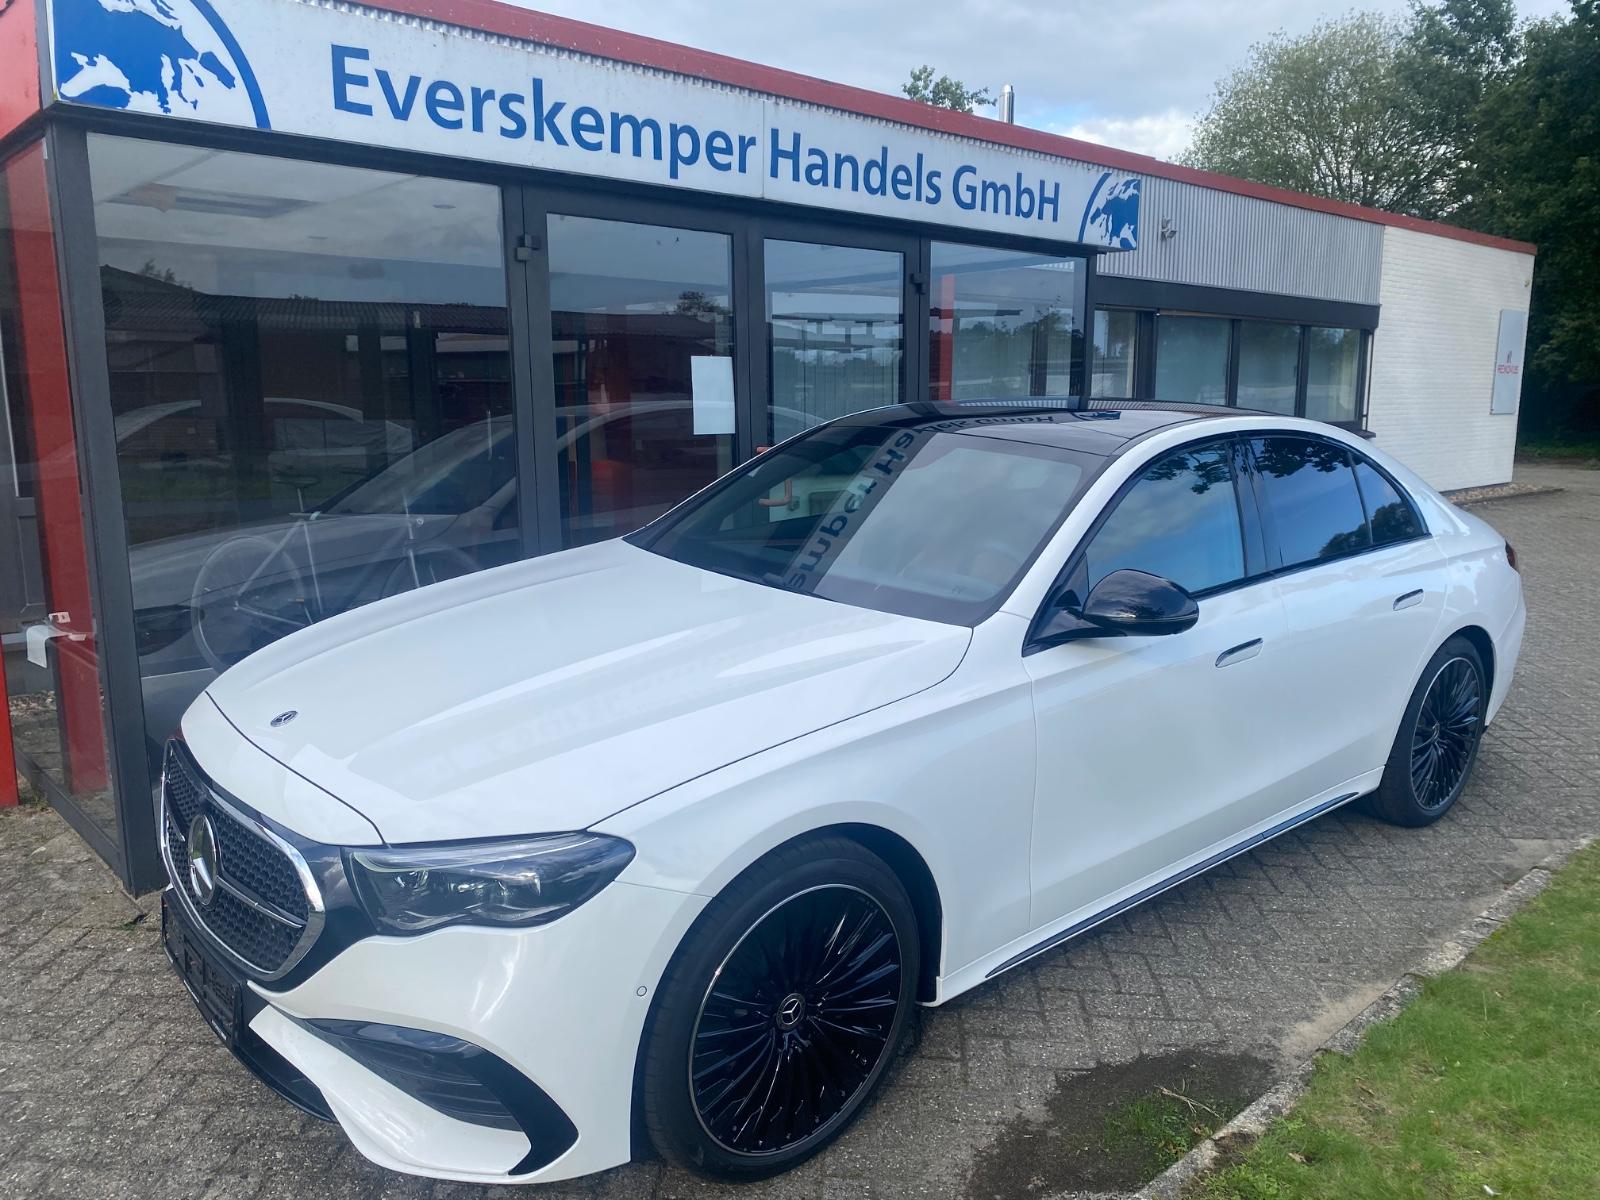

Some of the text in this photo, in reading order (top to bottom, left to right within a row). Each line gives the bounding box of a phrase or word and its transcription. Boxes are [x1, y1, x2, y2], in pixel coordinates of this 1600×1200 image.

[331, 44, 1060, 222] Everskemper Handels GmbH
